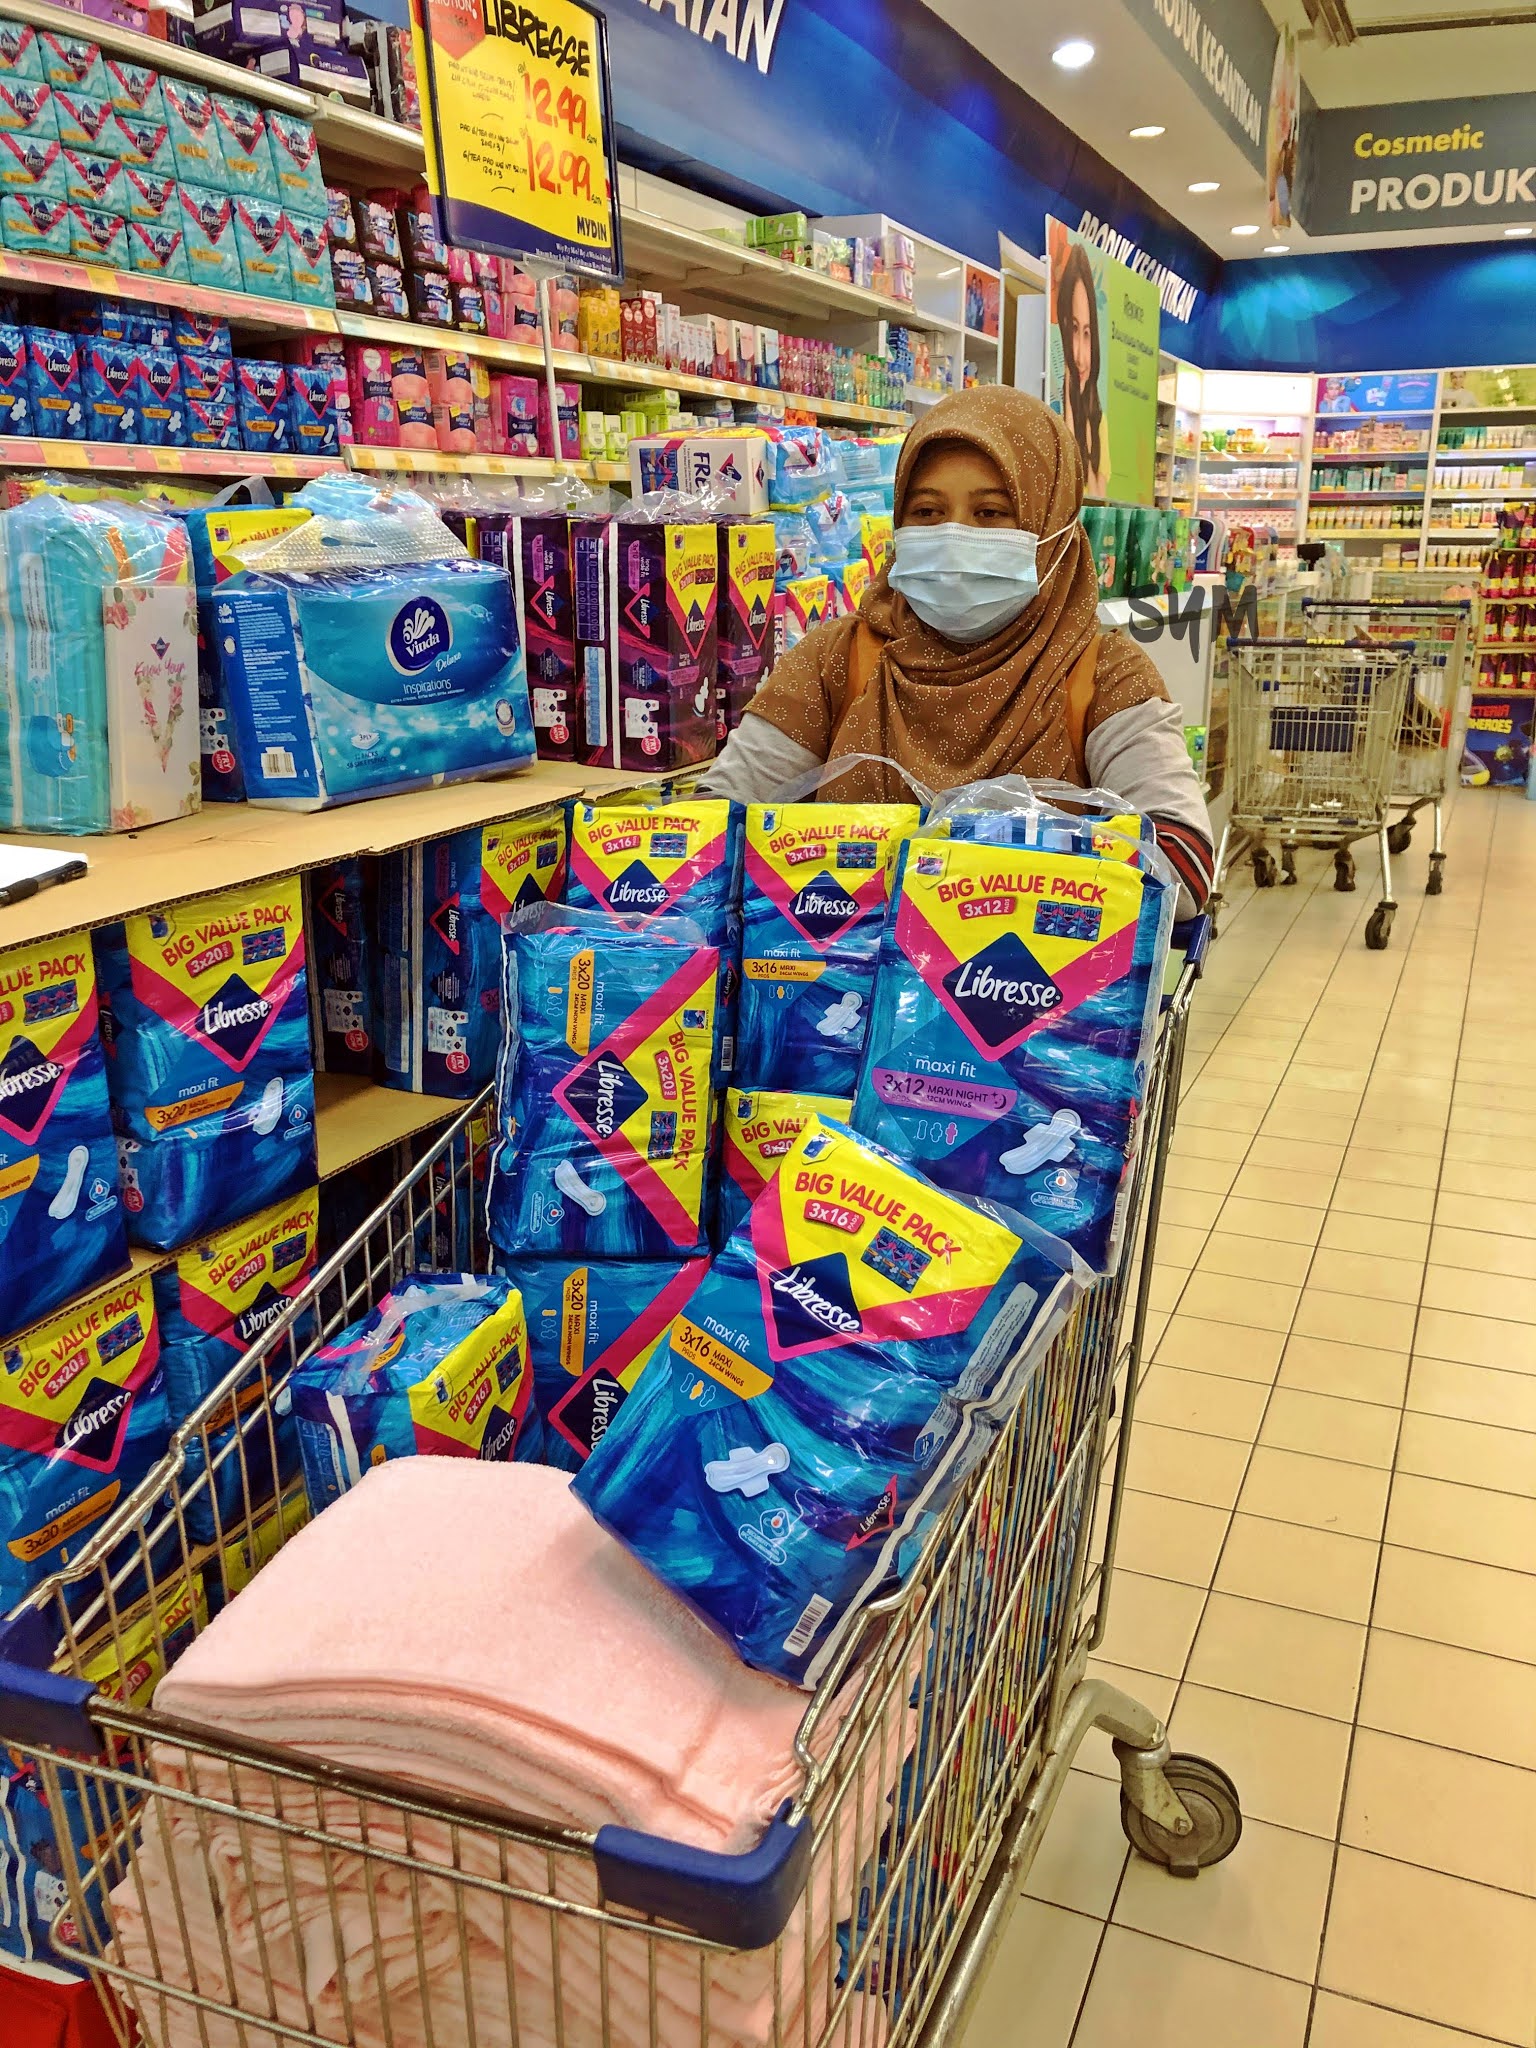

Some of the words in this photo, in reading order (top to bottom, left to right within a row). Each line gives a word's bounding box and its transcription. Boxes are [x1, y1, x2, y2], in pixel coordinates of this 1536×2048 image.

[482, 0, 591, 77] LIBRESSE
[1201, 23, 1262, 147] KECANTIKAN
[1353, 122, 1485, 159] Cosmetic
[526, 134, 591, 202] 12.99
[1349, 166, 1536, 215] PRODUK
[576, 215, 609, 242] MYDIN
[47, 360, 72, 374] Libresse
[106, 368, 129, 381] Libresse
[150, 372, 172, 385] Libresse
[545, 590, 555, 617] Libresse
[640, 598, 650, 626] Libresse
[749, 609, 767, 626] Libresse
[686, 615, 706, 633] Libresse
[405, 632, 440, 658] Vinda
[164, 657, 186, 675] Your
[435, 652, 462, 673] Deluxe
[403, 679, 452, 696] Inspirations
[587, 824, 613, 844] BIG
[615, 816, 659, 834] VALUE
[663, 816, 701, 833] PACK
[769, 832, 796, 854] BIG
[798, 824, 846, 843] VALUE
[849, 824, 891, 841] PACK
[498, 844, 513, 867] BIG
[606, 837, 631, 853] 3x16
[789, 848, 816, 864] 3x16
[609, 880, 668, 903] Libresse
[794, 891, 859, 915] Libresse
[937, 877, 975, 903] BIG
[979, 873, 1047, 894] VALUE
[1050, 877, 1108, 906] PACK
[963, 898, 1001, 918] 3x12
[162, 934, 195, 967] BIG
[195, 912, 251, 944] VALUE
[253, 905, 293, 927] PACK
[448, 908, 460, 942] Libresse
[190, 946, 223, 975] 3x20
[763, 948, 789, 958] maxi
[790, 948, 801, 958] fit
[39, 952, 87, 983] PACK
[578, 958, 591, 990] 3x20
[751, 961, 777, 974] 3x16
[595, 981, 605, 1011] maxi
[954, 961, 1061, 1008] Libresse
[203, 1001, 272, 1035] Libresse
[594, 1011, 606, 1026] fit
[455, 1053, 465, 1070] TRY
[668, 1031, 690, 1064] BIG
[657, 1055, 675, 1090] 3x20
[915, 1055, 956, 1075] maxi
[960, 1061, 977, 1078] fit
[178, 1079, 206, 1098] maxi
[207, 1076, 220, 1090] fit
[596, 1059, 626, 1138] Libresse
[678, 1065, 697, 1124] VALUE
[882, 1073, 925, 1097] 3x12
[927, 1084, 954, 1097] MAXI
[955, 1089, 990, 1104] NIGHT
[156, 1103, 187, 1125] 3x20
[946, 1097, 972, 1109] WINGS
[741, 1121, 770, 1144] BIG
[774, 1117, 808, 1135] VAL
[673, 1128, 697, 1171] PACK
[795, 1171, 834, 1195] BIG
[839, 1178, 906, 1226] VALUE
[903, 1212, 962, 1261] PACK
[808, 1202, 848, 1228] 3x16
[847, 1213, 860, 1231] PADS
[207, 1253, 237, 1286] BIG
[238, 1223, 280, 1260] VALUE
[282, 1209, 315, 1236] PACK
[231, 1260, 259, 1289] 3x20
[571, 1278, 584, 1311] 3x20
[773, 1265, 860, 1333] Libresse
[573, 1314, 581, 1335] MAXI
[588, 1300, 599, 1332] maxi
[18, 1358, 51, 1399] BIG
[50, 1310, 101, 1361] VALUE
[103, 1286, 145, 1324] PACK
[587, 1332, 600, 1345] fit
[679, 1326, 712, 1358] 3x16
[703, 1315, 737, 1344] maxi
[734, 1334, 752, 1354] fit
[681, 1346, 697, 1361] PADS
[712, 1349, 734, 1368] MAXI
[47, 1358, 79, 1395] 3x20
[448, 1391, 469, 1423] BIG
[499, 1321, 522, 1353] PACK
[708, 1358, 725, 1374] 24CM
[724, 1370, 745, 1387] WINGS
[466, 1388, 486, 1421] 3x16
[45, 1493, 75, 1521] maxi
[76, 1485, 91, 1500] fit
[859, 1491, 892, 1533] Libresse
